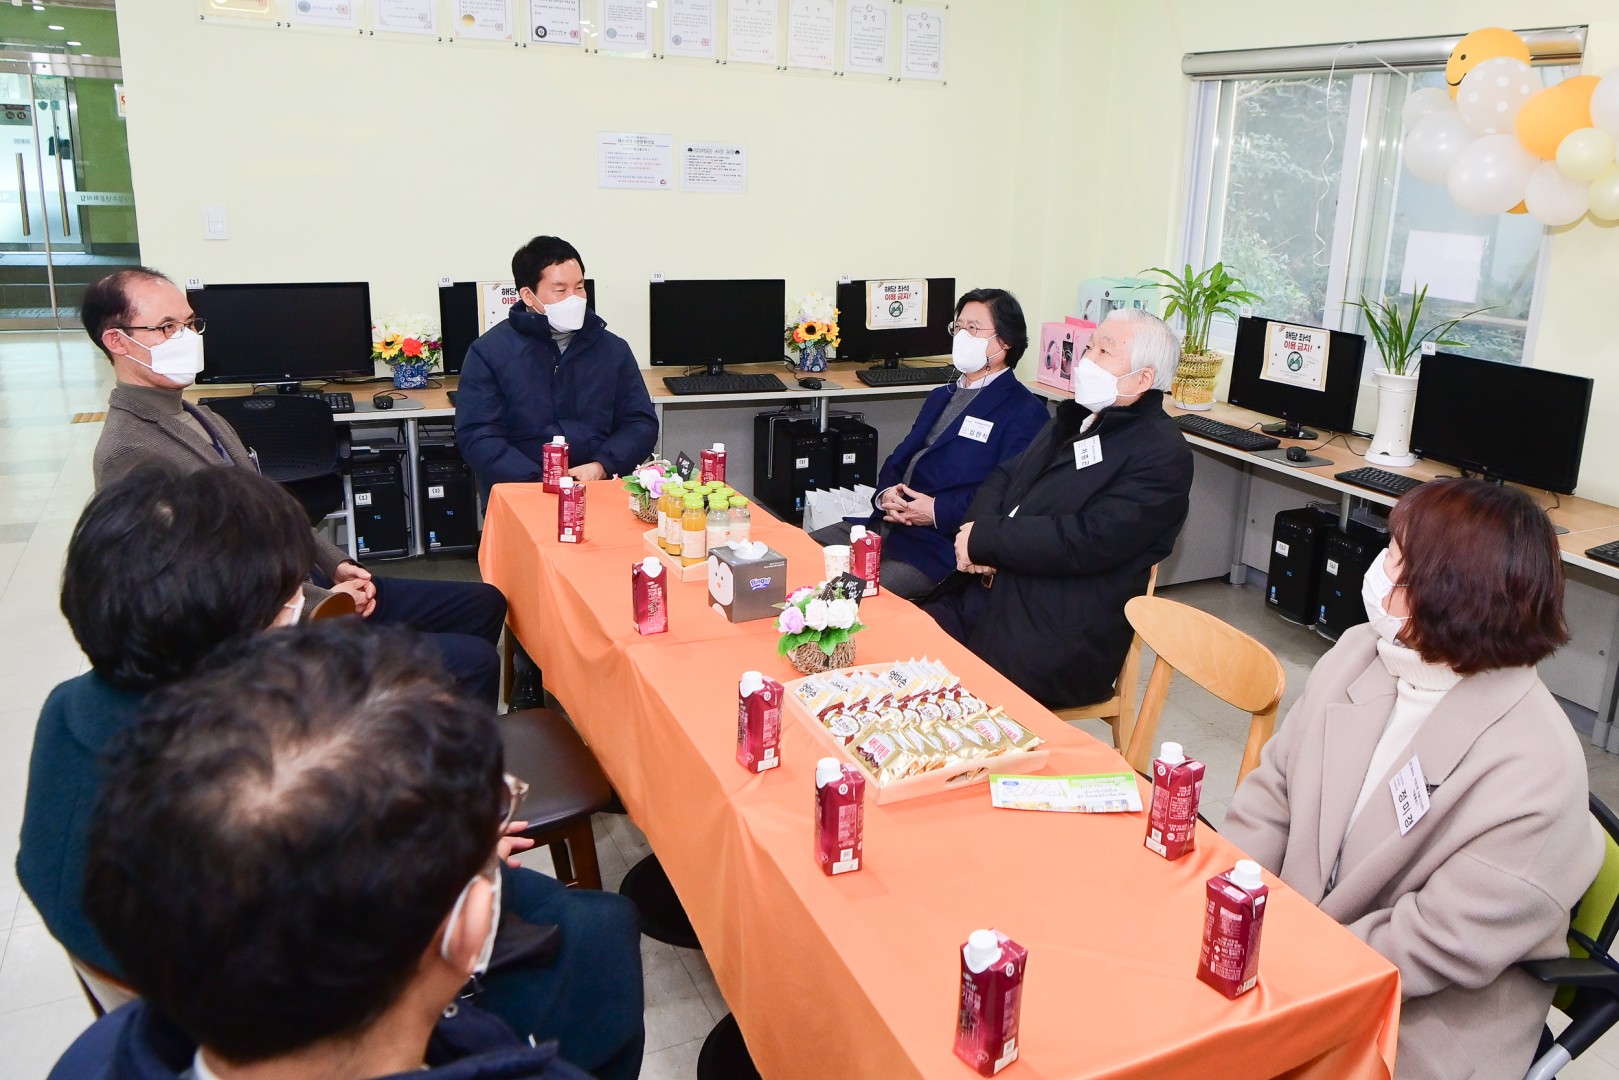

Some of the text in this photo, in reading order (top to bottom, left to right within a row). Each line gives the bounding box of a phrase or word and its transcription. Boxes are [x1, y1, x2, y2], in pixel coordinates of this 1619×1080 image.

[501, 288, 517, 296] 해당
[884, 285, 897, 293] 해당
[884, 292, 912, 301] 이용 금지!
[1284, 331, 1312, 343] 해당 좌석
[1283, 340, 1313, 353] 이용 금지!
[889, 670, 907, 688] 엄마손
[799, 683, 817, 699] 엄마손
[1398, 788, 1414, 828] 정미경
